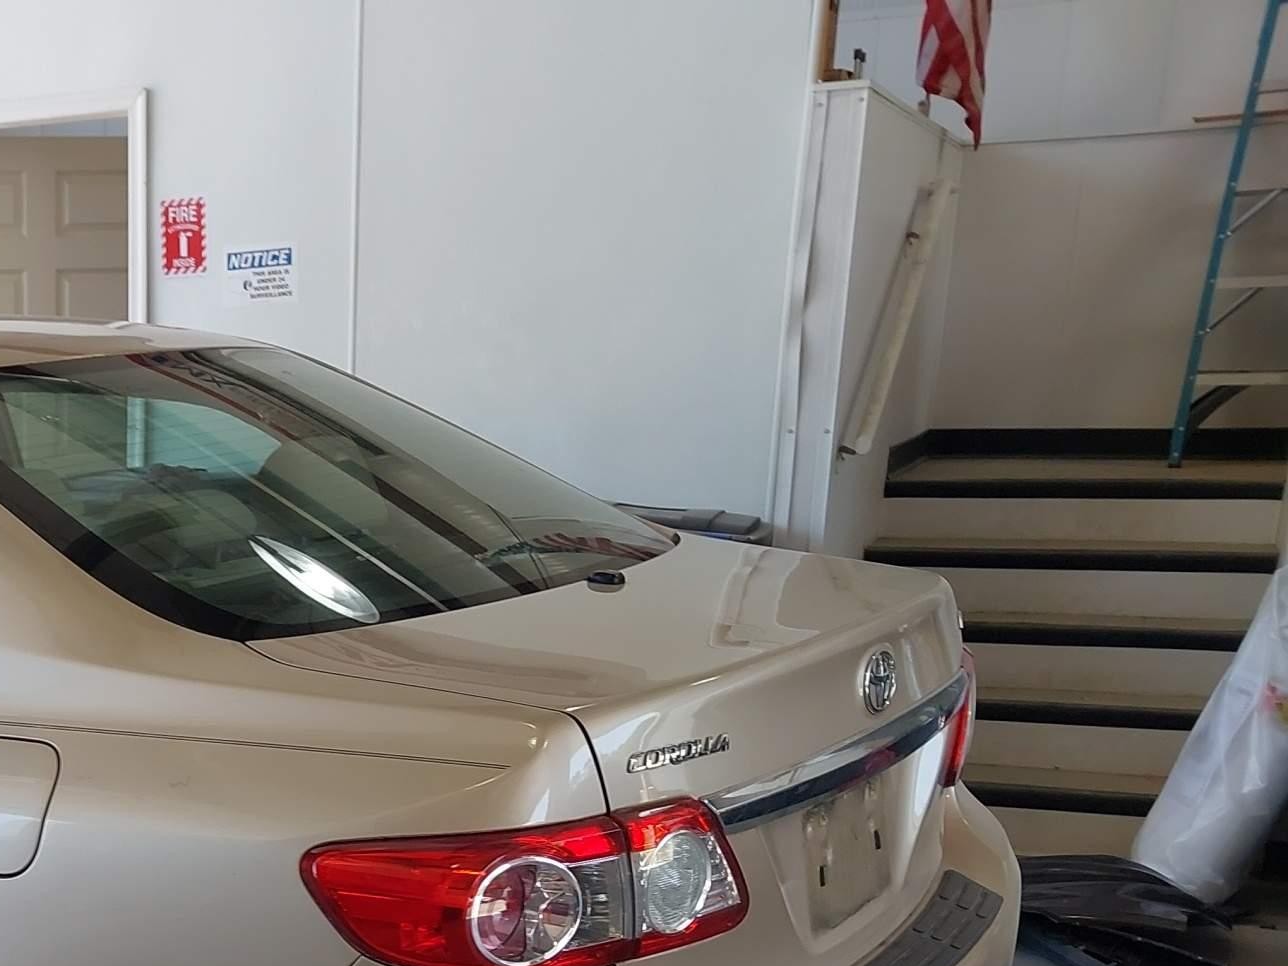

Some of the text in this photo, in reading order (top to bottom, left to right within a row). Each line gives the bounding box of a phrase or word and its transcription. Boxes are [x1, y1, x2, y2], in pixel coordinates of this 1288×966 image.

[167, 205, 199, 224] FIRE
[229, 249, 290, 269] NOTICE
[627, 733, 730, 773] COROLLA
